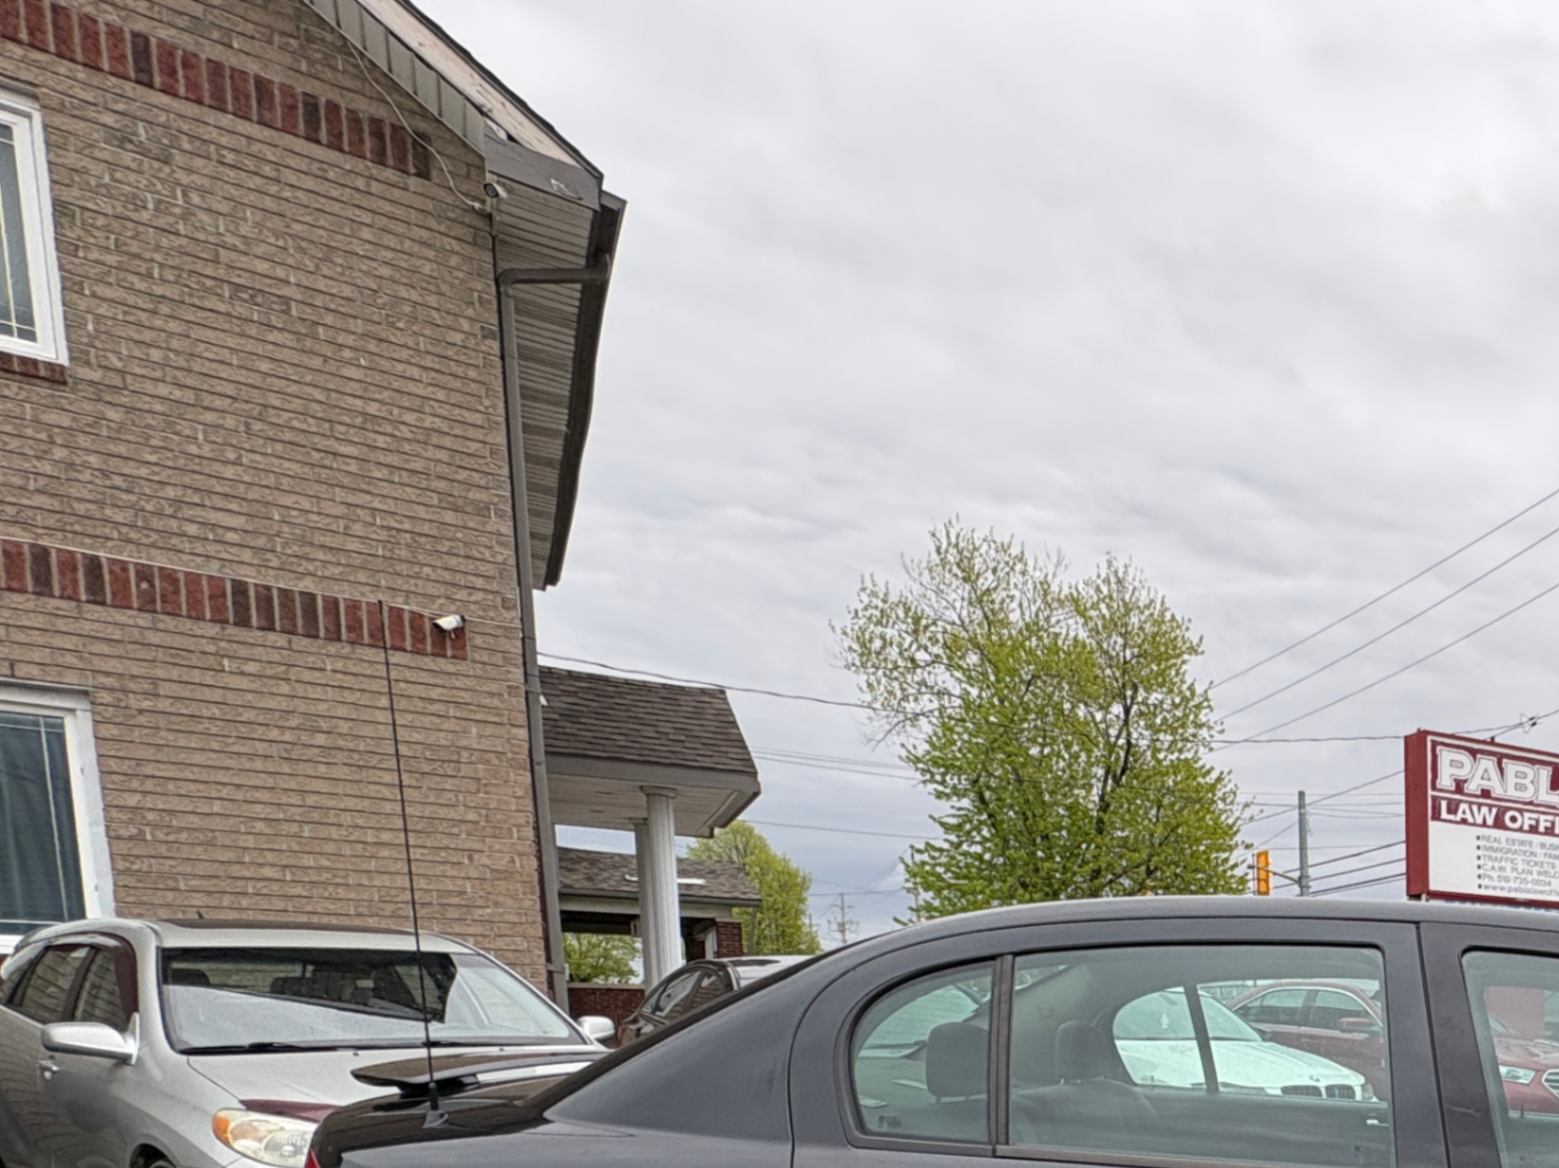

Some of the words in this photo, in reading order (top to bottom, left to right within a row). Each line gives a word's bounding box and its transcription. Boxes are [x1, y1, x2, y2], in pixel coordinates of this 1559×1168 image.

[1440, 800, 1498, 826] LAW
[1481, 835, 1502, 845] REAL
[1505, 838, 1534, 849] ESTATE
[1482, 845, 1537, 858] IMMIGRATION
[1482, 854, 1518, 866] TRAFFIC
[1522, 859, 1557, 870] TICKETS
[1511, 867, 1534, 877] PLAN
